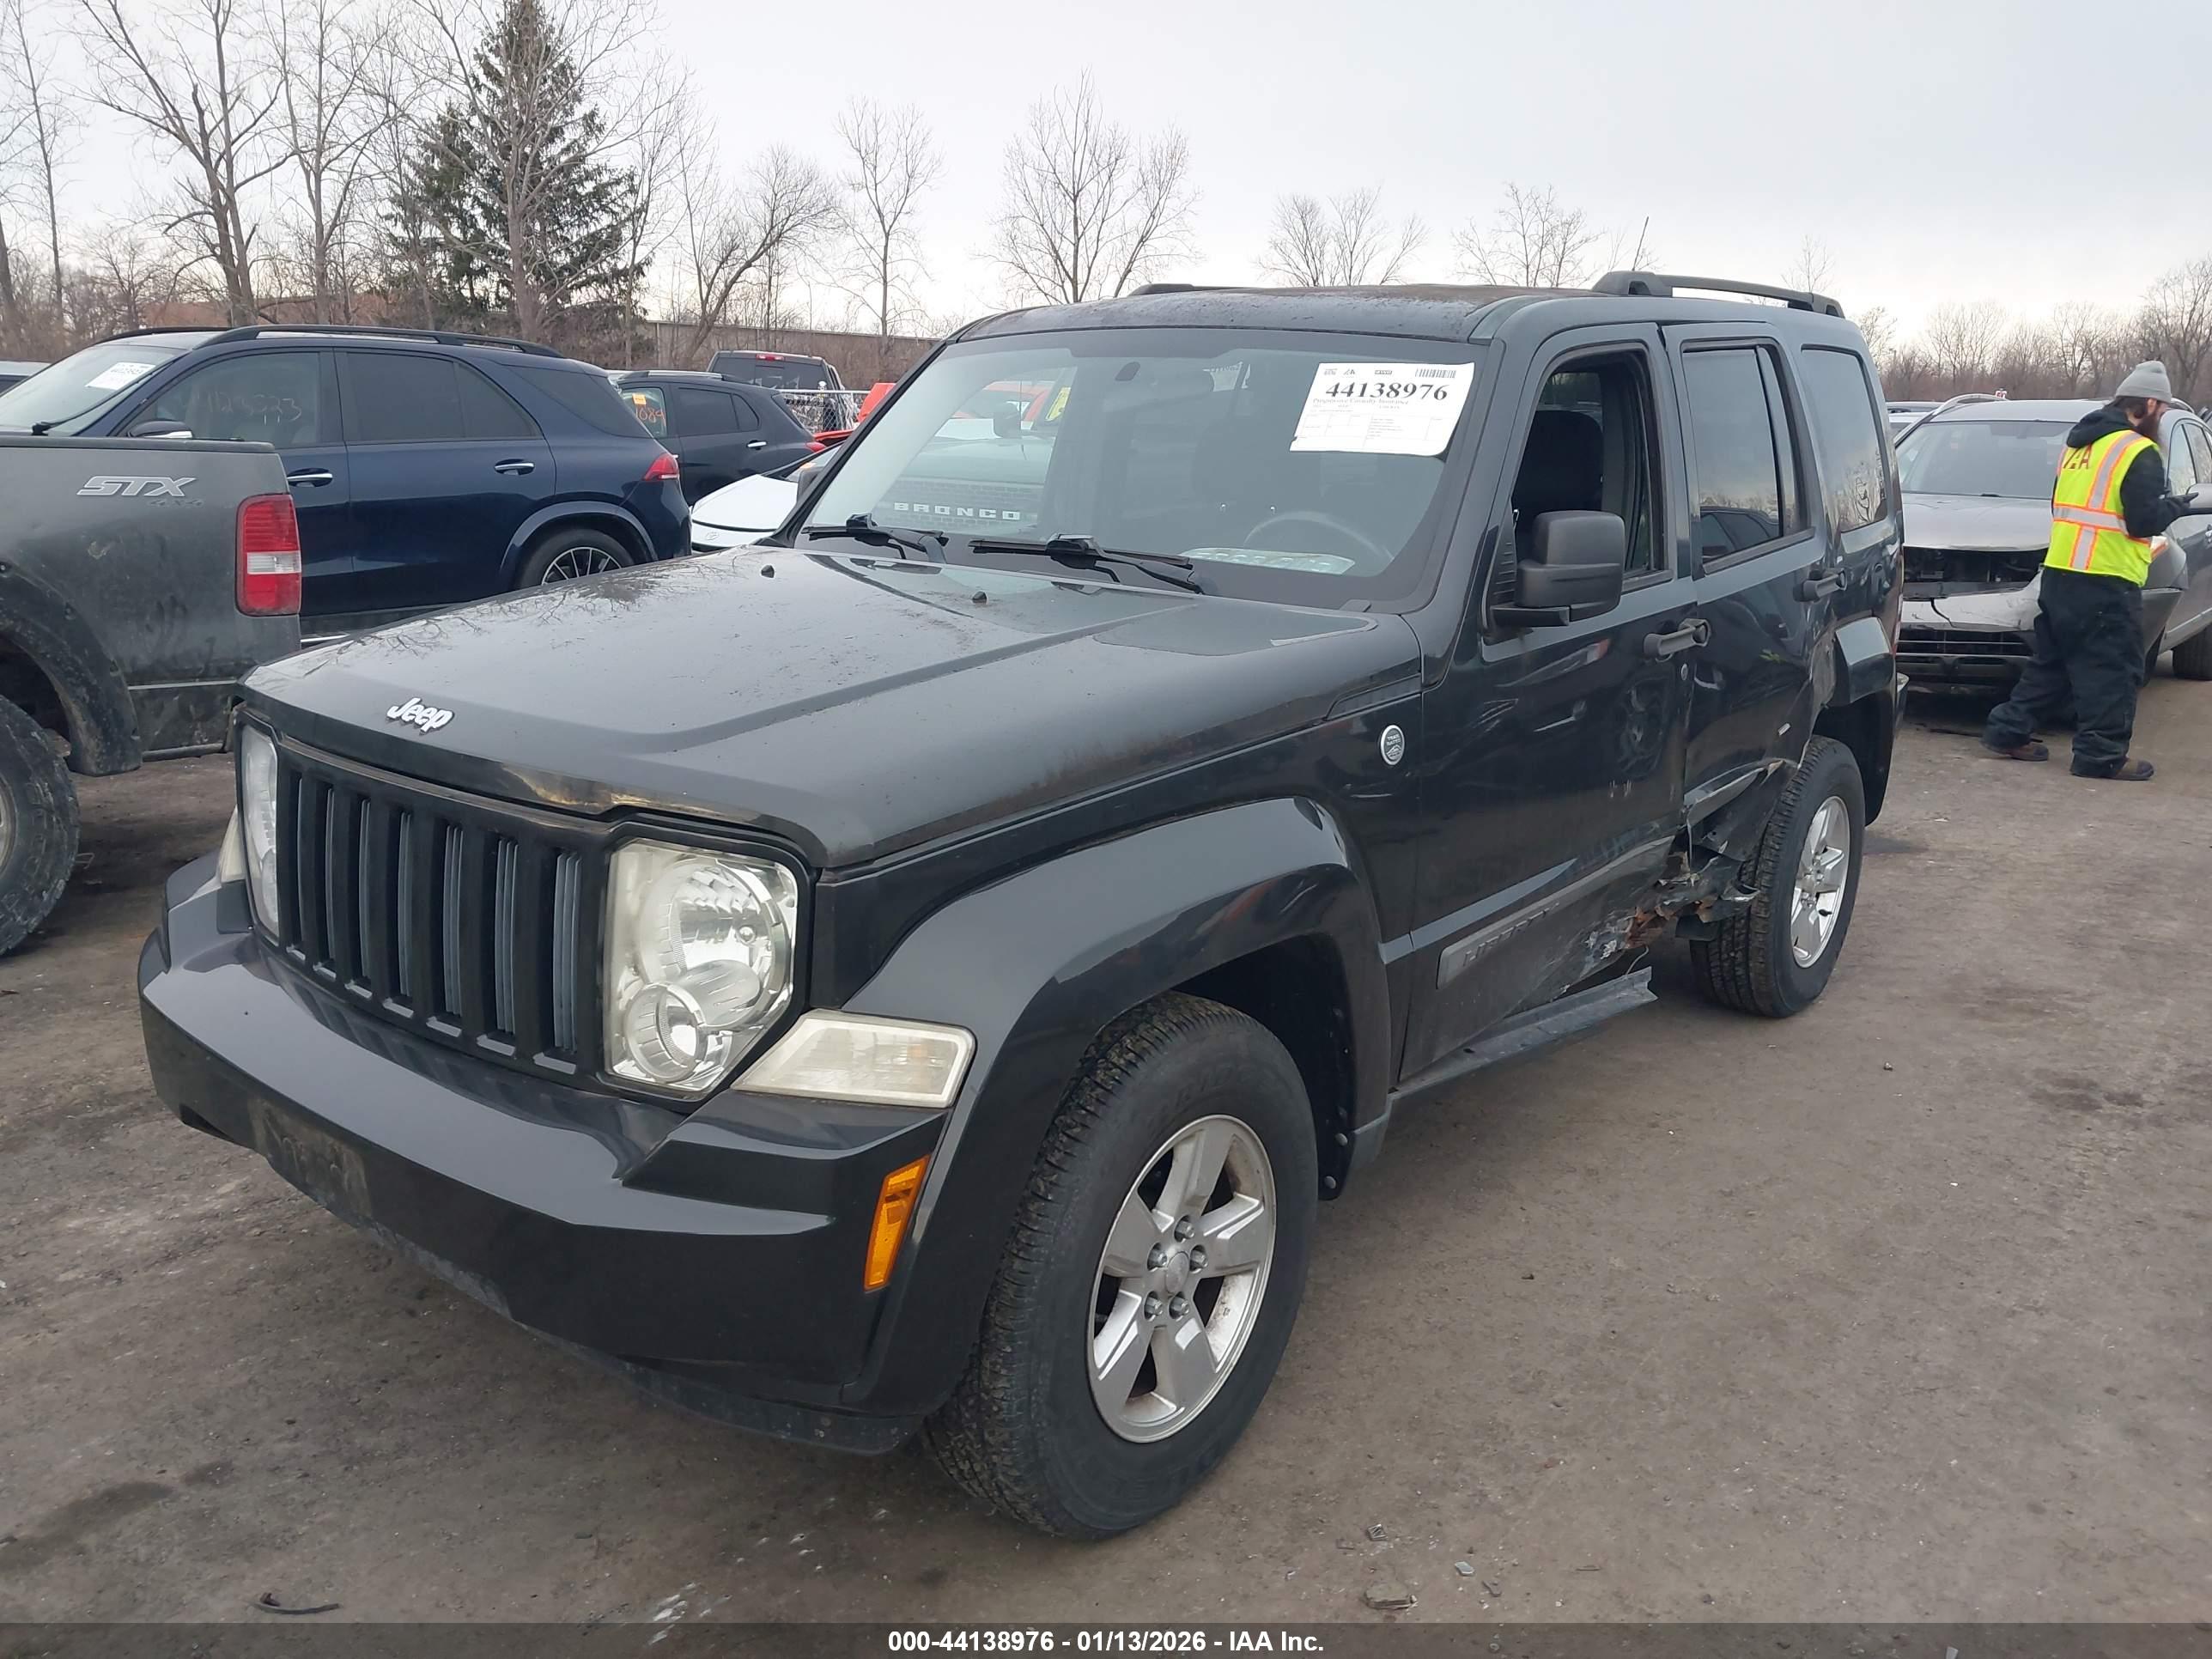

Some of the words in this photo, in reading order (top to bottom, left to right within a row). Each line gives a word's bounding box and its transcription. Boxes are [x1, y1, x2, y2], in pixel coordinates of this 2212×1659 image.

[1326, 382, 1449, 401] 44138976
[76, 476, 196, 497] STX
[894, 502, 1021, 520] BRONCO
[386, 697, 454, 732] Jeep
